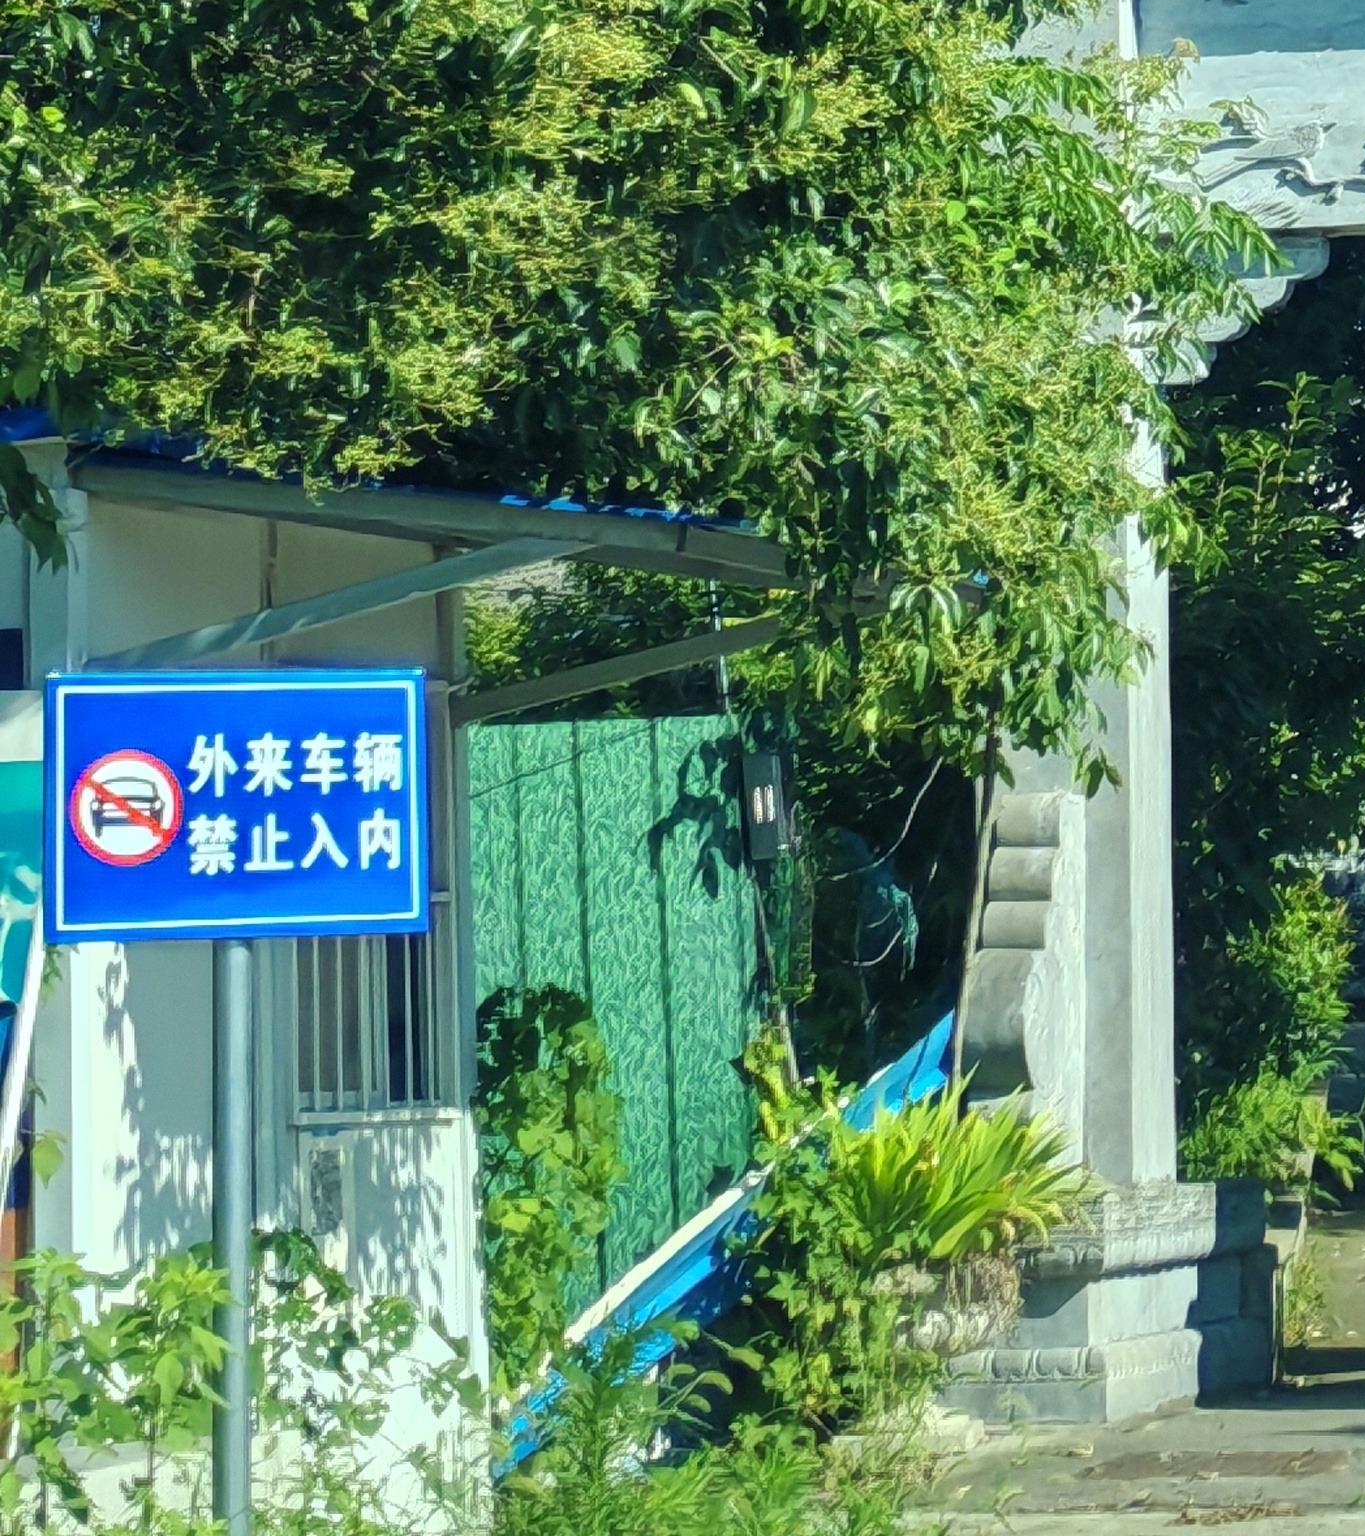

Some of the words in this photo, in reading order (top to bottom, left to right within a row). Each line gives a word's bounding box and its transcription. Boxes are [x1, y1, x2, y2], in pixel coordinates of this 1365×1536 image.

[187, 731, 403, 797] 外来车辆
[188, 808, 401, 875] 禁止入内
